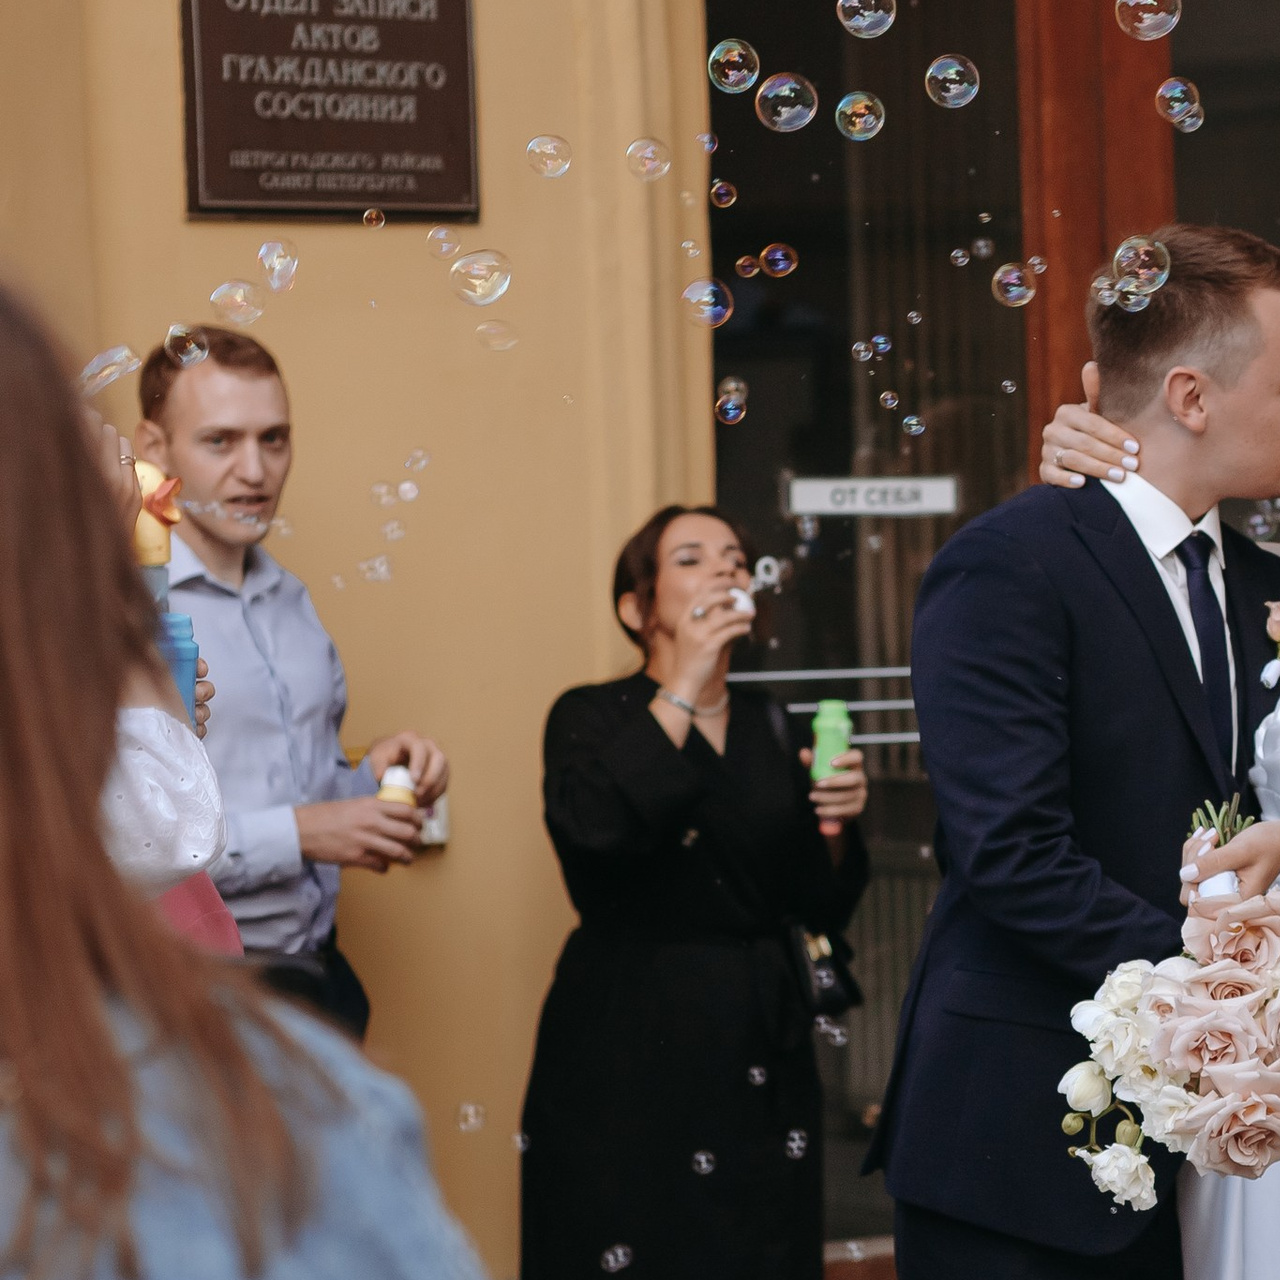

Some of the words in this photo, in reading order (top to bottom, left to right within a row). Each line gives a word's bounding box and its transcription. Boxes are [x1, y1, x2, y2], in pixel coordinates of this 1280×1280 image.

[290, 22, 381, 53] АКТОВ
[221, 53, 447, 90] ГРАЖДАНСКОГО
[254, 89, 417, 123] СОСТОЯНИЯ
[229, 149, 376, 170] ПЕТРОГРАДСКОГО
[830, 487, 858, 506] ОТ
[864, 486, 922, 506] СЕБЯ
